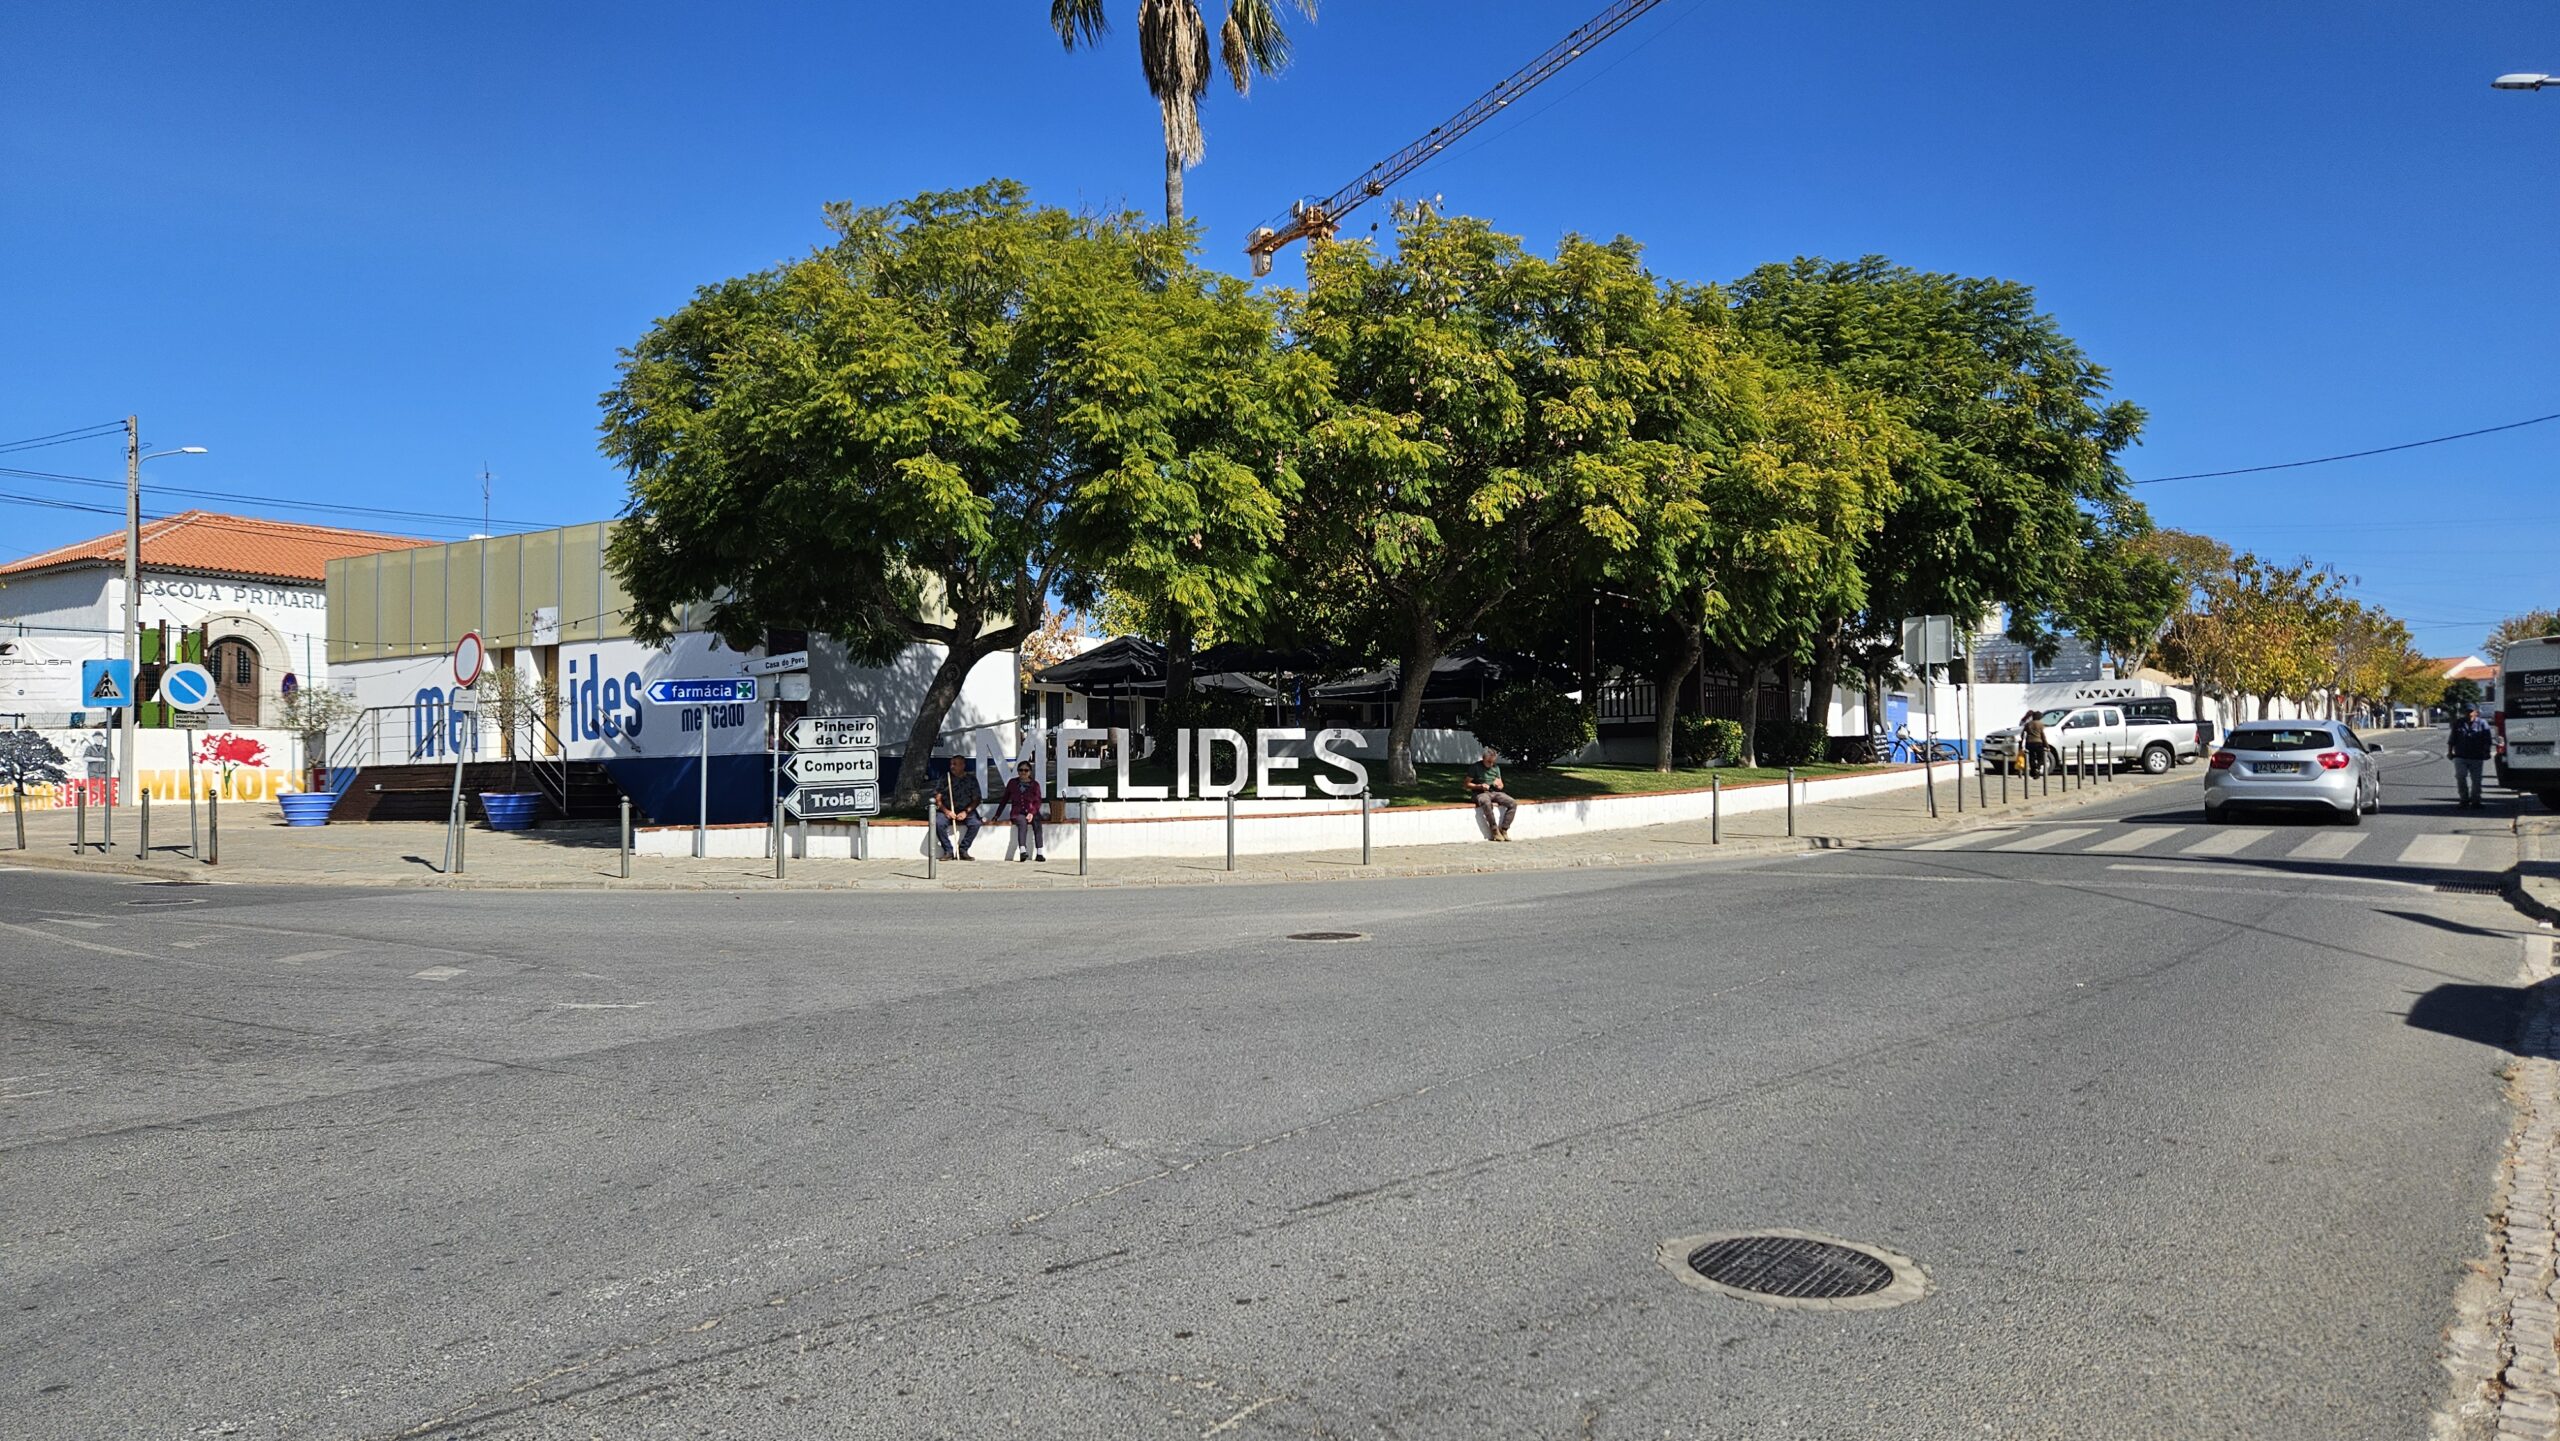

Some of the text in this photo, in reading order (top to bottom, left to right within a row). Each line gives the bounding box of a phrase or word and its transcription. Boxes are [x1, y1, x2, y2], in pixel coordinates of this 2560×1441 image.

[141, 580, 221, 601] ESCOLA
[765, 661, 780, 669] Casa
[569, 653, 643, 742] ides
[672, 684, 732, 698] farmácia
[814, 720, 875, 732] Pinheiro
[816, 734, 871, 745] da Cruz
[804, 759, 874, 774] Comporta
[976, 727, 1369, 800] MELIDES
[811, 791, 855, 808] Troia
